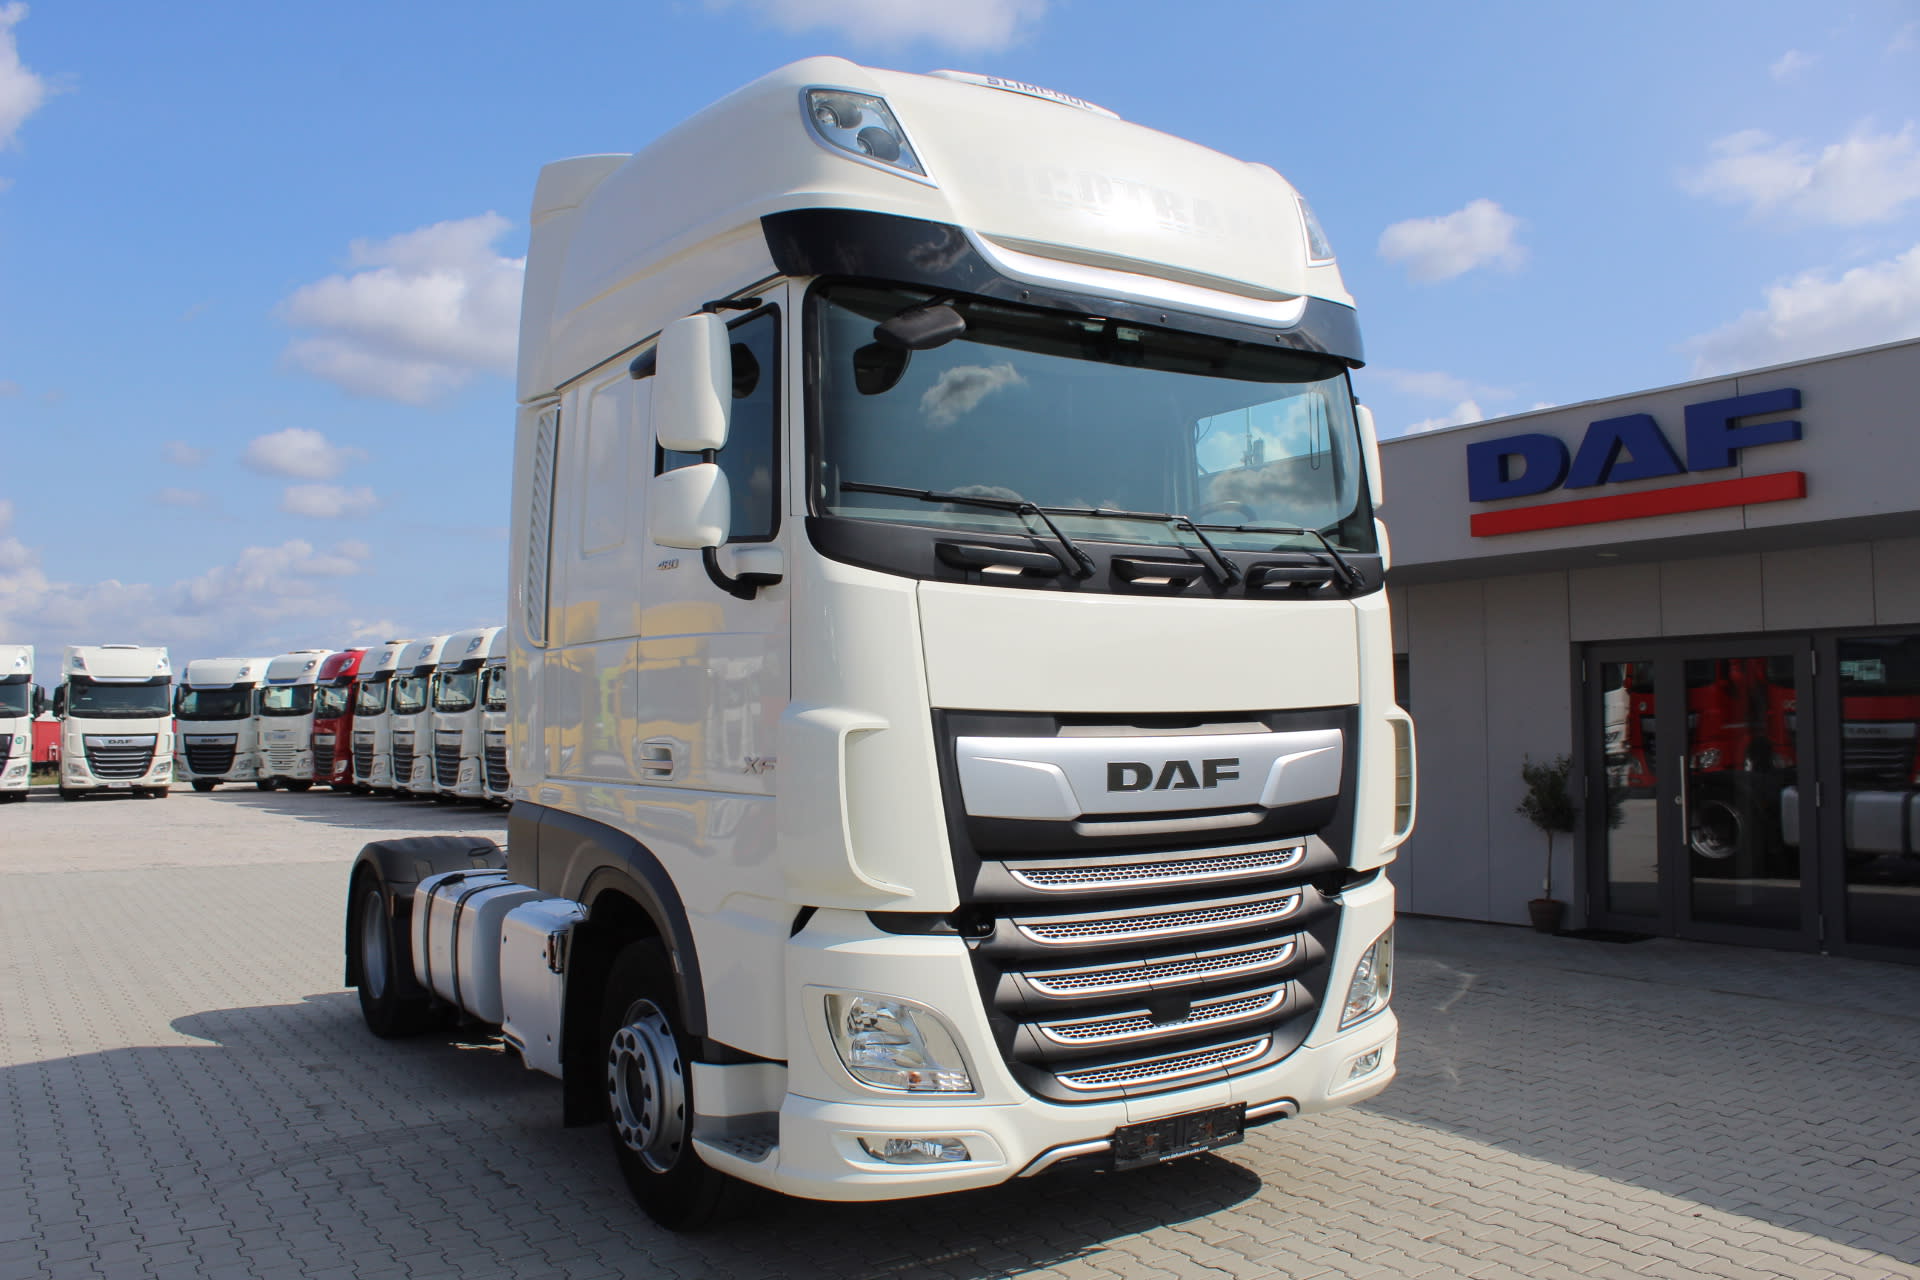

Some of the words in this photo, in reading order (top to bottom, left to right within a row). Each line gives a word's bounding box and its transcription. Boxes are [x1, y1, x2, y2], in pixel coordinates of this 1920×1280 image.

[1467, 388, 1802, 502] DAF
[743, 756, 777, 774] XF
[1106, 757, 1240, 793] DAF
